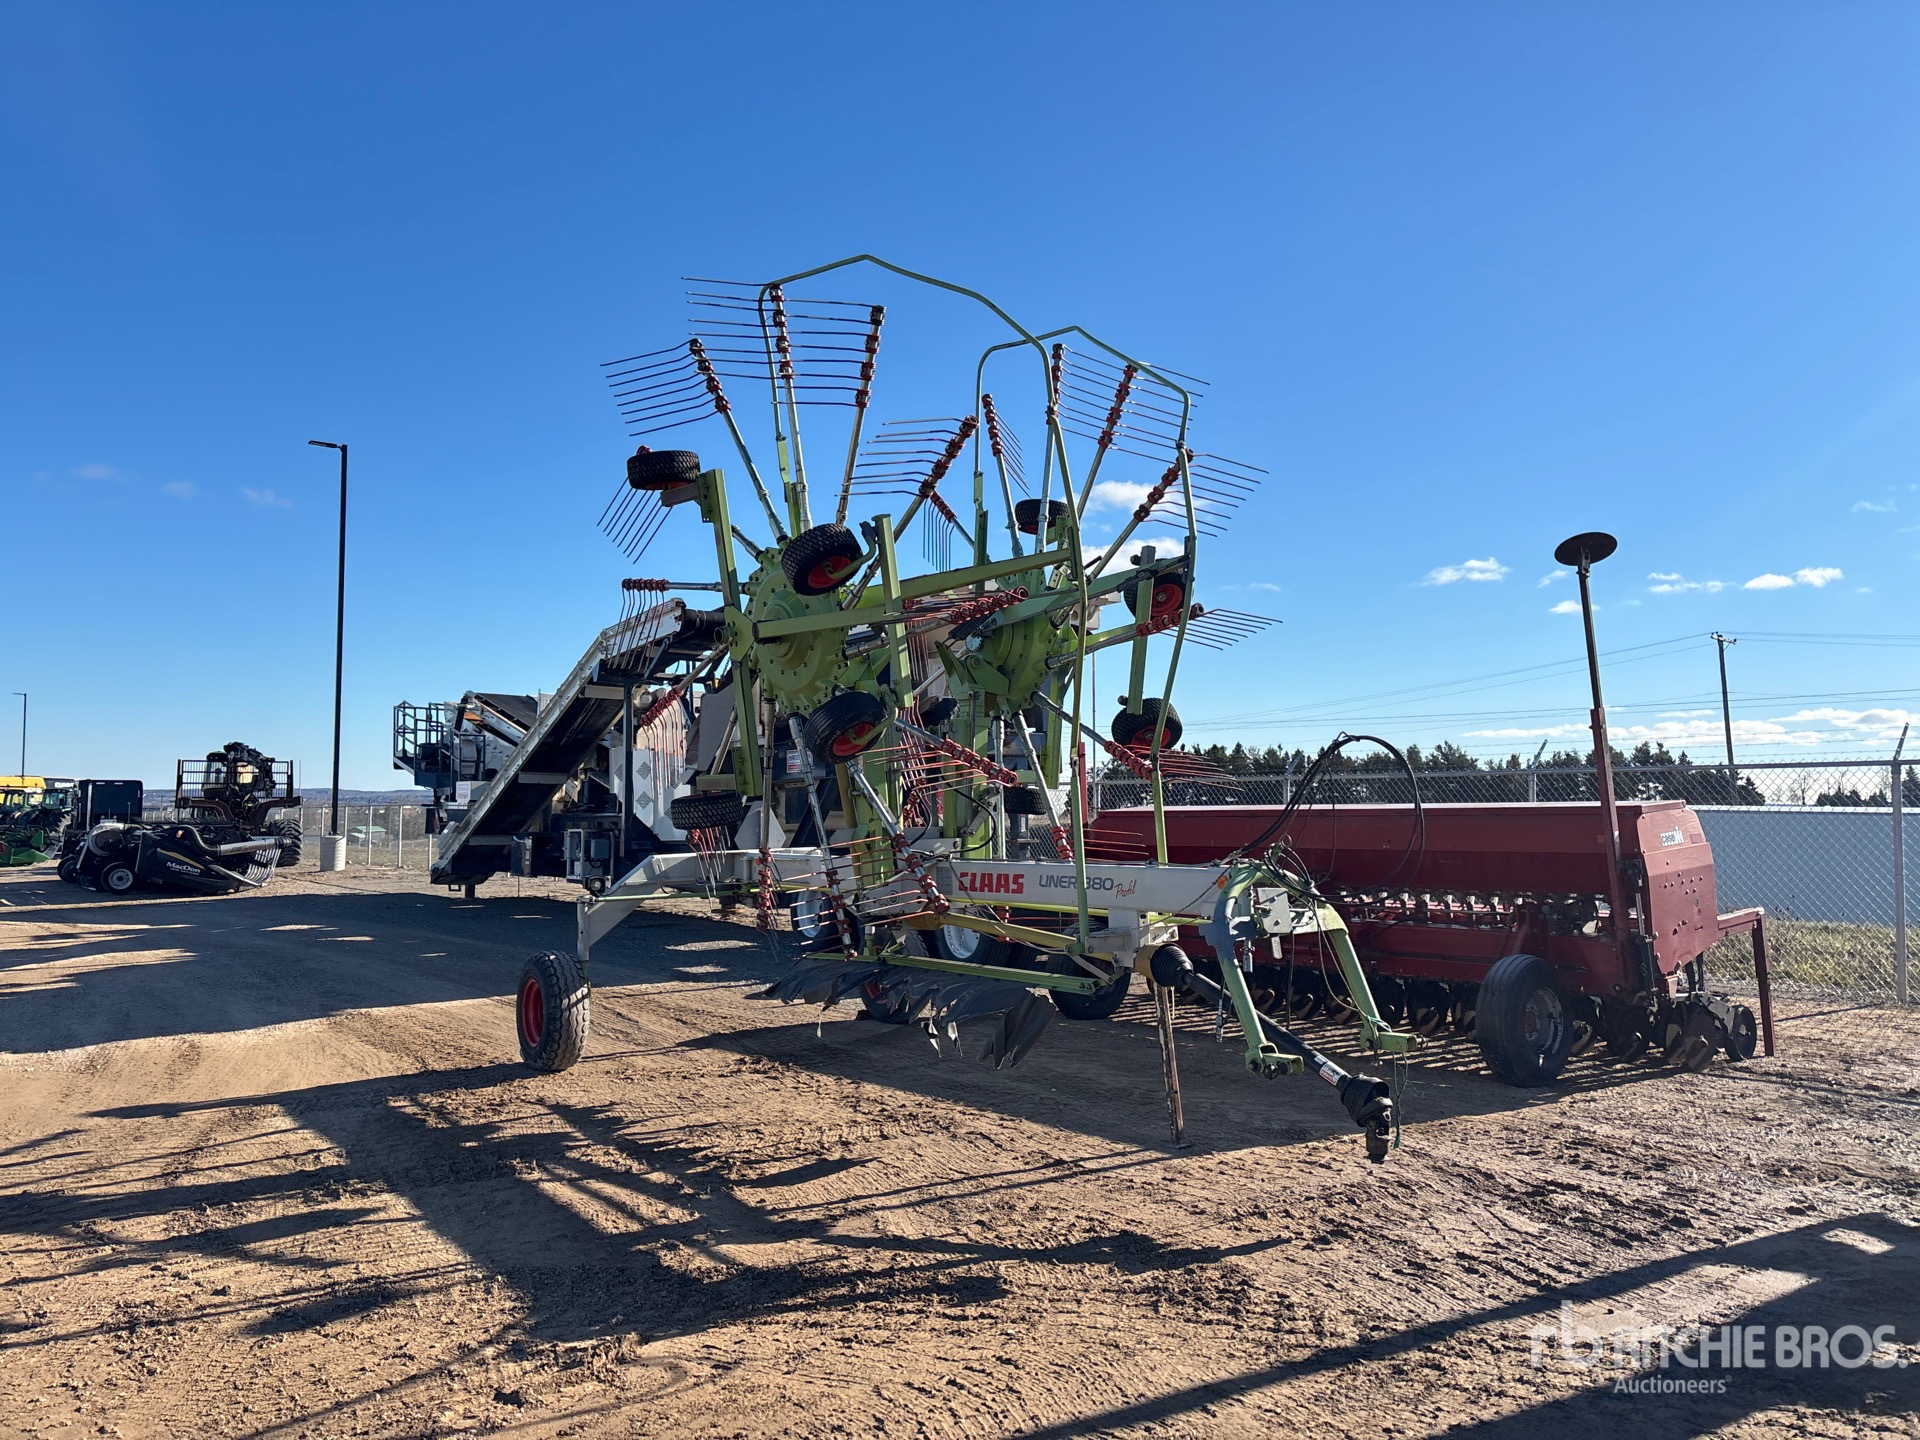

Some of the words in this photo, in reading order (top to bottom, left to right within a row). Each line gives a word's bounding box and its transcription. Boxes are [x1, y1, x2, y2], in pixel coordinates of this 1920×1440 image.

[166, 861, 201, 874] MacDon
[958, 872, 1024, 894] CLAAS
[1115, 879, 1137, 898] Profil
